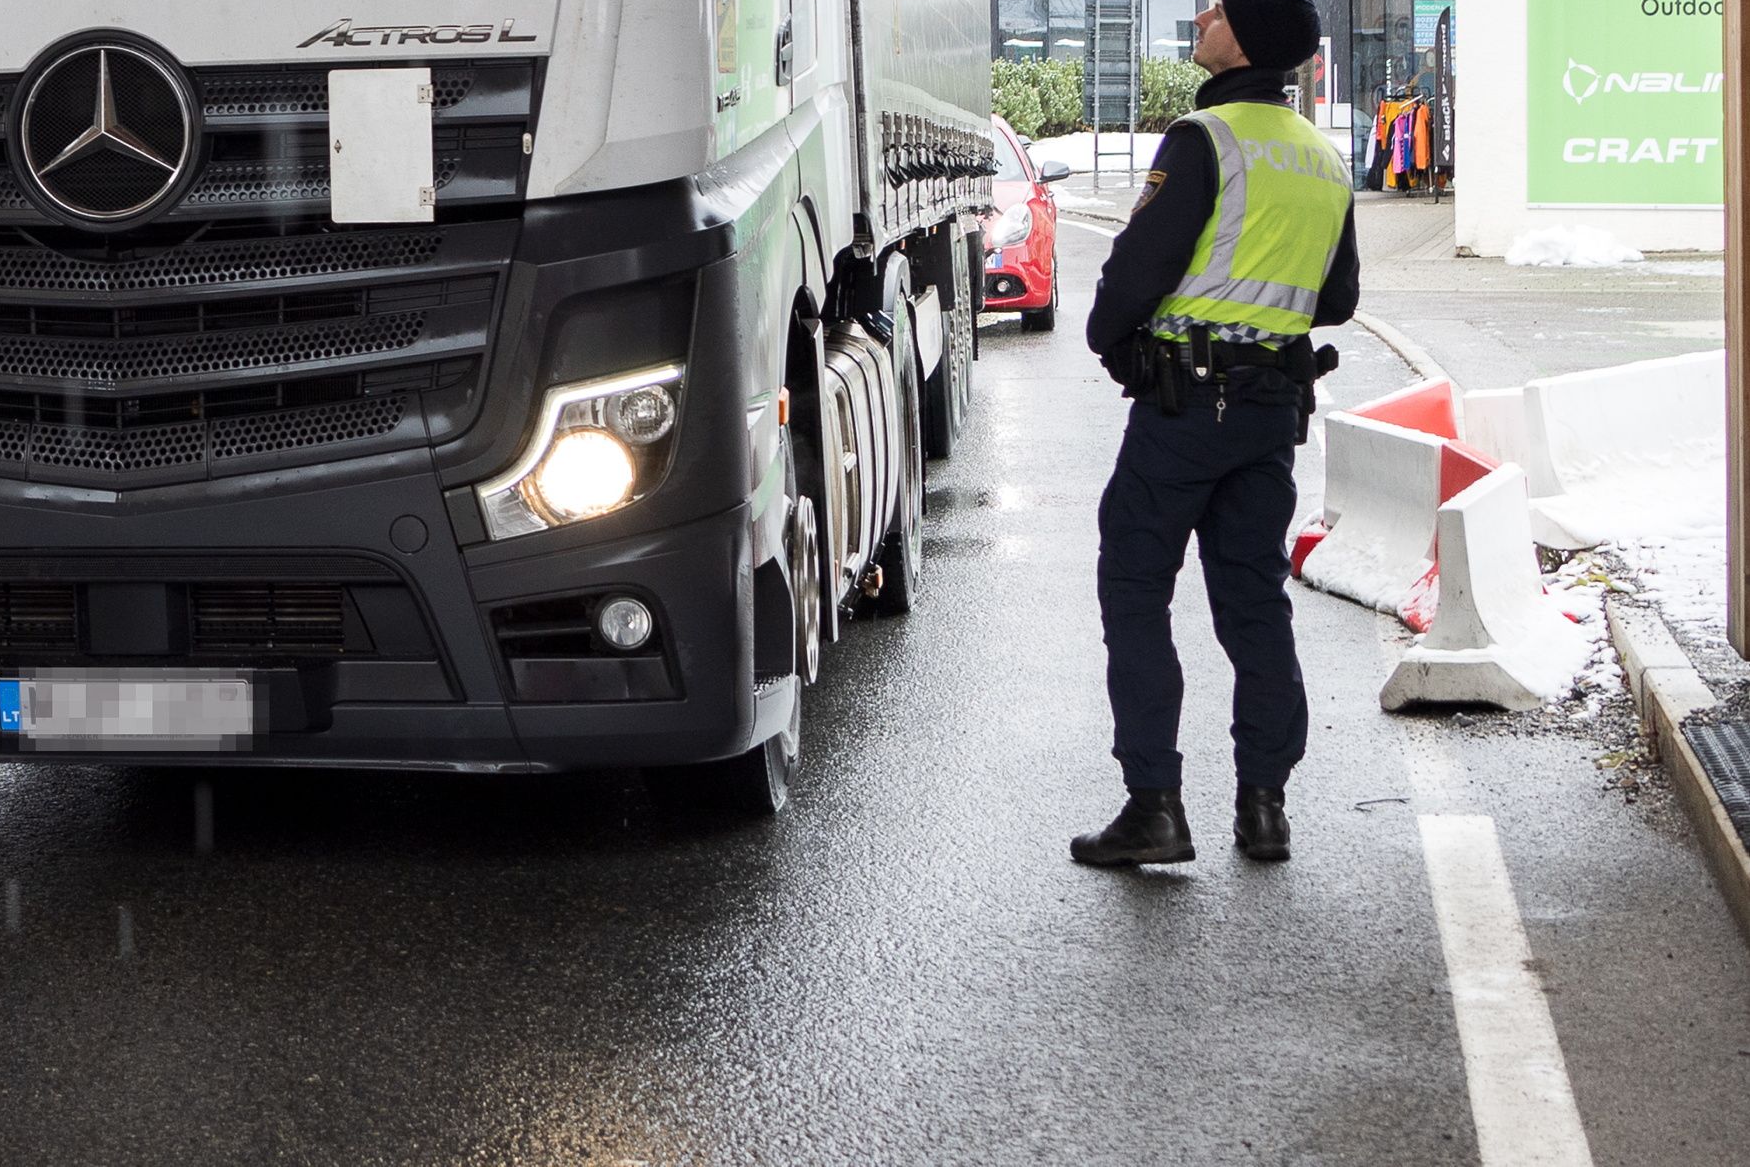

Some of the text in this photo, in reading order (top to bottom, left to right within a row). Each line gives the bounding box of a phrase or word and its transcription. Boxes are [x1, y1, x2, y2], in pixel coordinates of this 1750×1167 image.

[296, 17, 537, 48] ACTROS L
[1563, 137, 1719, 164] CRAFT
[2, 711, 20, 723] LT
